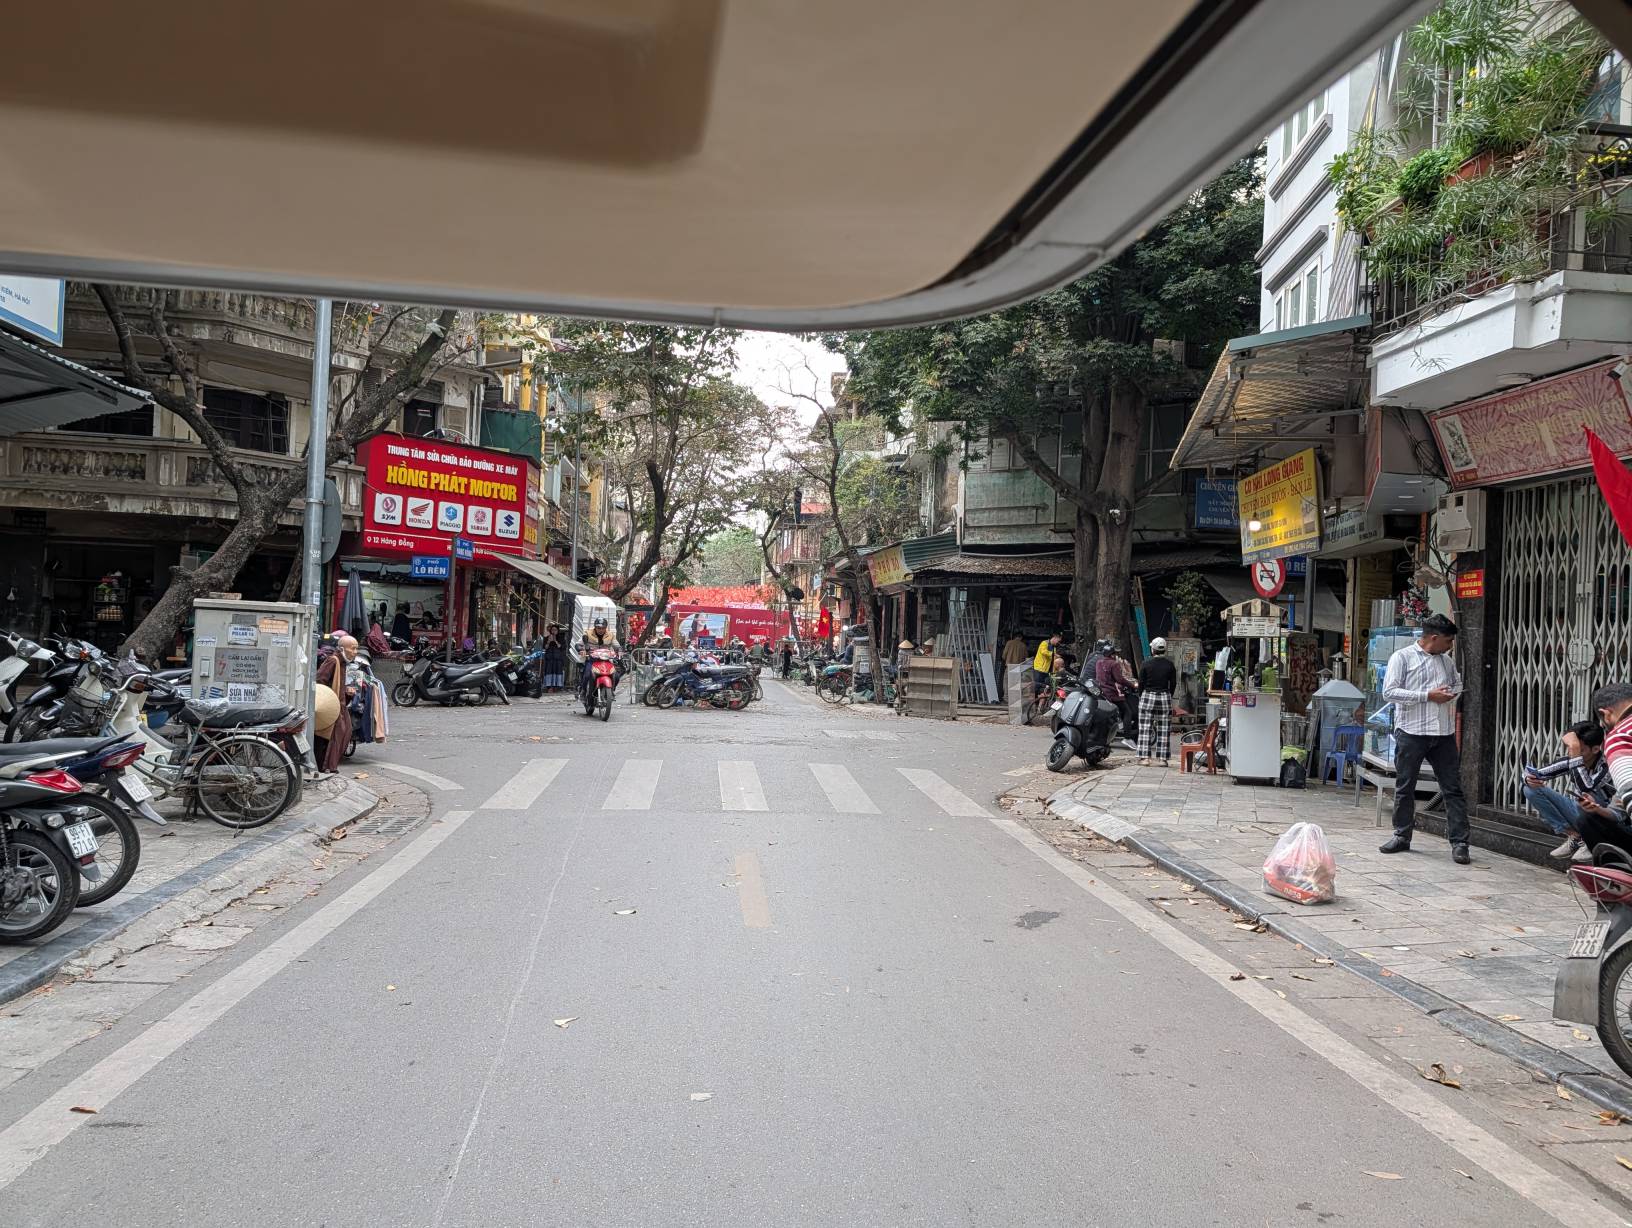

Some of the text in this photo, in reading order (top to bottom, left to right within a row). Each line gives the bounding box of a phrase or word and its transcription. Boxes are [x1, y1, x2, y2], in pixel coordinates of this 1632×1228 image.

[387, 445, 518, 476] TRUNG TÂM SỬA CHỮA BẢO DƯỠNG XE MÁY
[386, 461, 429, 491] HỒNG
[430, 471, 468, 494] PHÁT
[469, 478, 518, 502] MOTOR
[381, 513, 396, 521] SYM
[408, 517, 431, 526] HONDA
[440, 521, 461, 529] PIAGGIO
[498, 528, 518, 536] SUZUKI
[415, 564, 446, 575] LÒ RÈN
[69, 825, 91, 841] 99-F1
